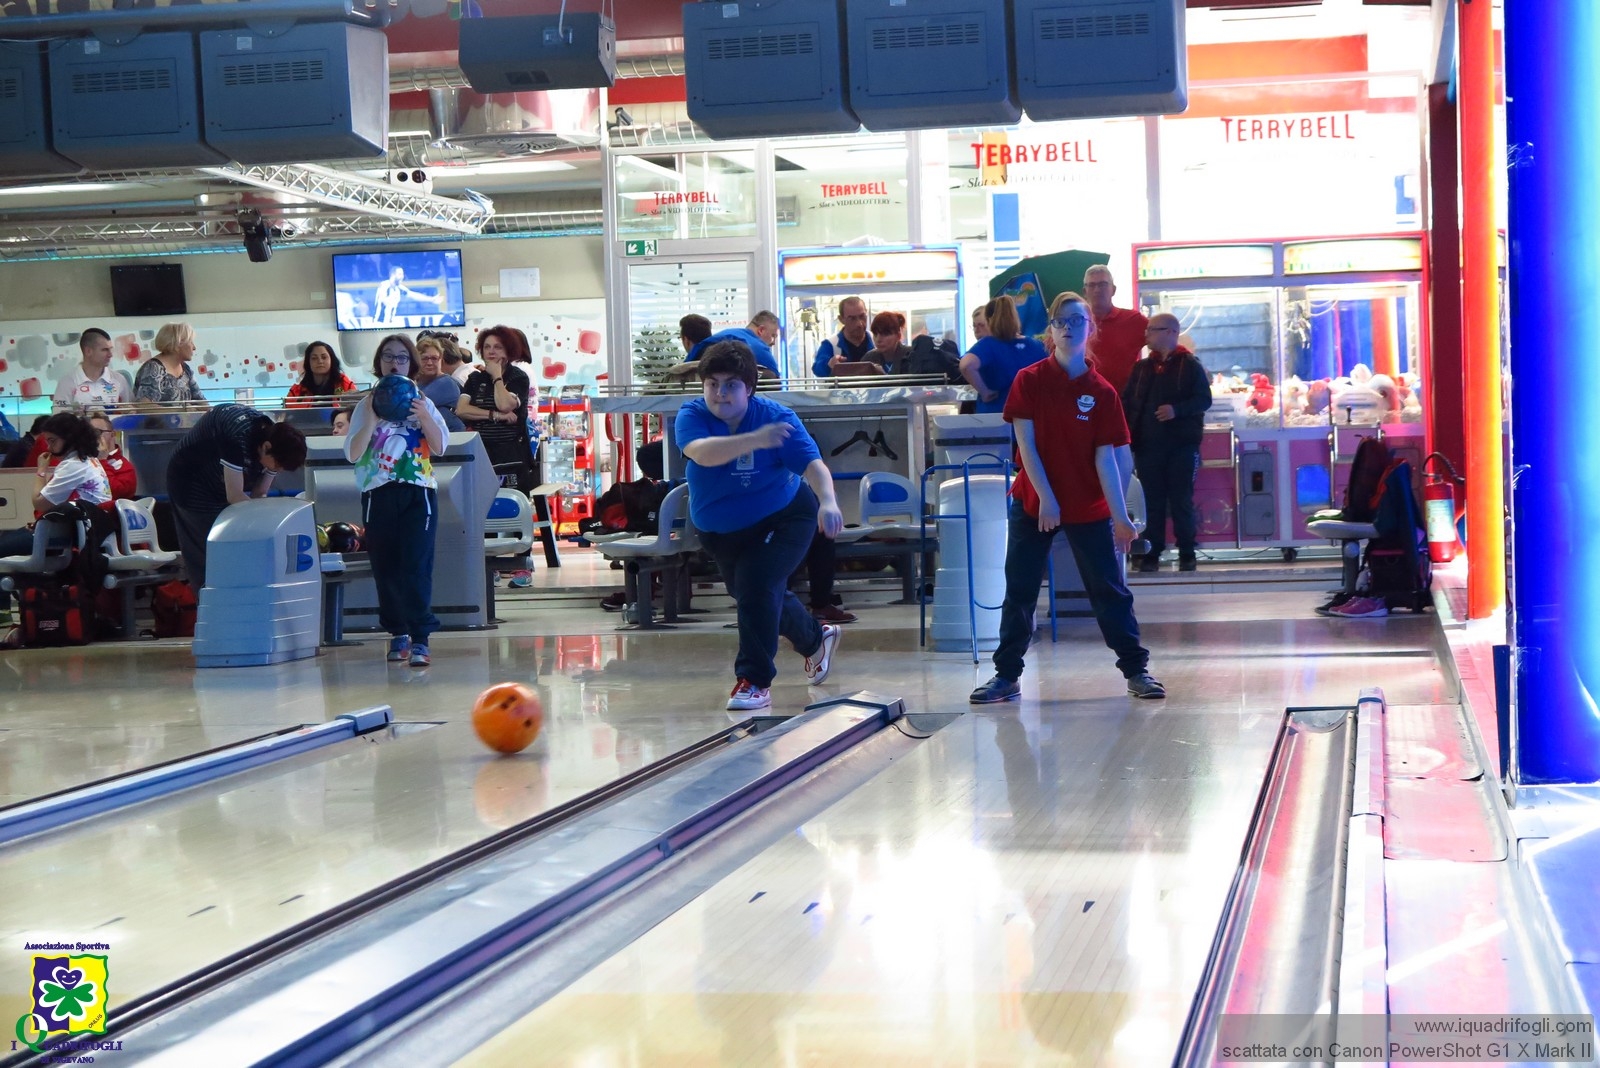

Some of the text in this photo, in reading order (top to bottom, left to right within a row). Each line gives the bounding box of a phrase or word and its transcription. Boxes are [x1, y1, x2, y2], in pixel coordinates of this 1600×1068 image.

[1220, 113, 1356, 143] TERRYBELL
[970, 139, 1098, 169] TERRYBELL
[821, 181, 888, 198] TERRYBELL
[654, 191, 719, 206] TERRYBELL
[836, 198, 891, 206] VIDEOLOTTERY
